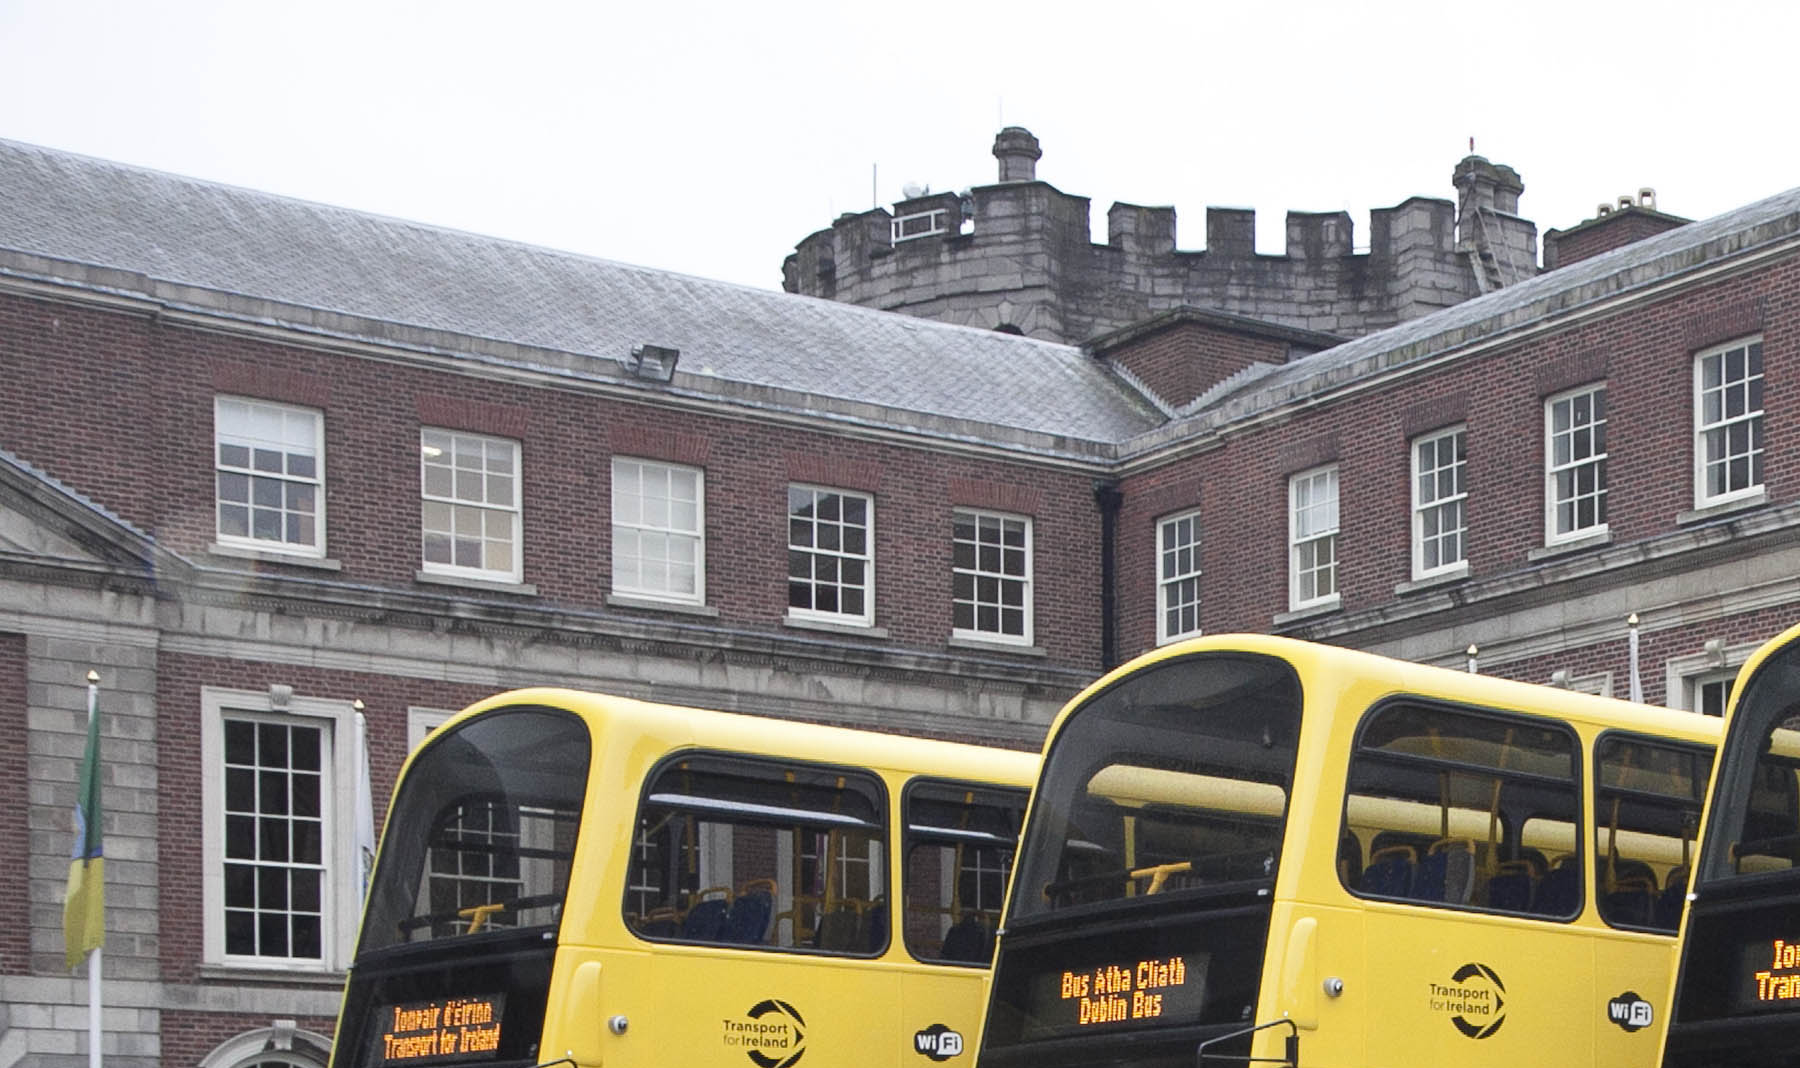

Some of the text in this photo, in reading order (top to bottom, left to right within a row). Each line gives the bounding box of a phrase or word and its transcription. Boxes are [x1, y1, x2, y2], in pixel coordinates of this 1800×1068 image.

[1061, 971, 1090, 998] Bus
[1136, 957, 1185, 989] Cliath
[1429, 984, 1490, 1000] Transport
[1079, 990, 1162, 1024] Dublin Bus
[1429, 1000, 1490, 1015] for Ireland
[723, 1019, 788, 1035] Transport
[384, 1023, 500, 1059] Transport for Ireland
[723, 1035, 788, 1049] for Ireland
